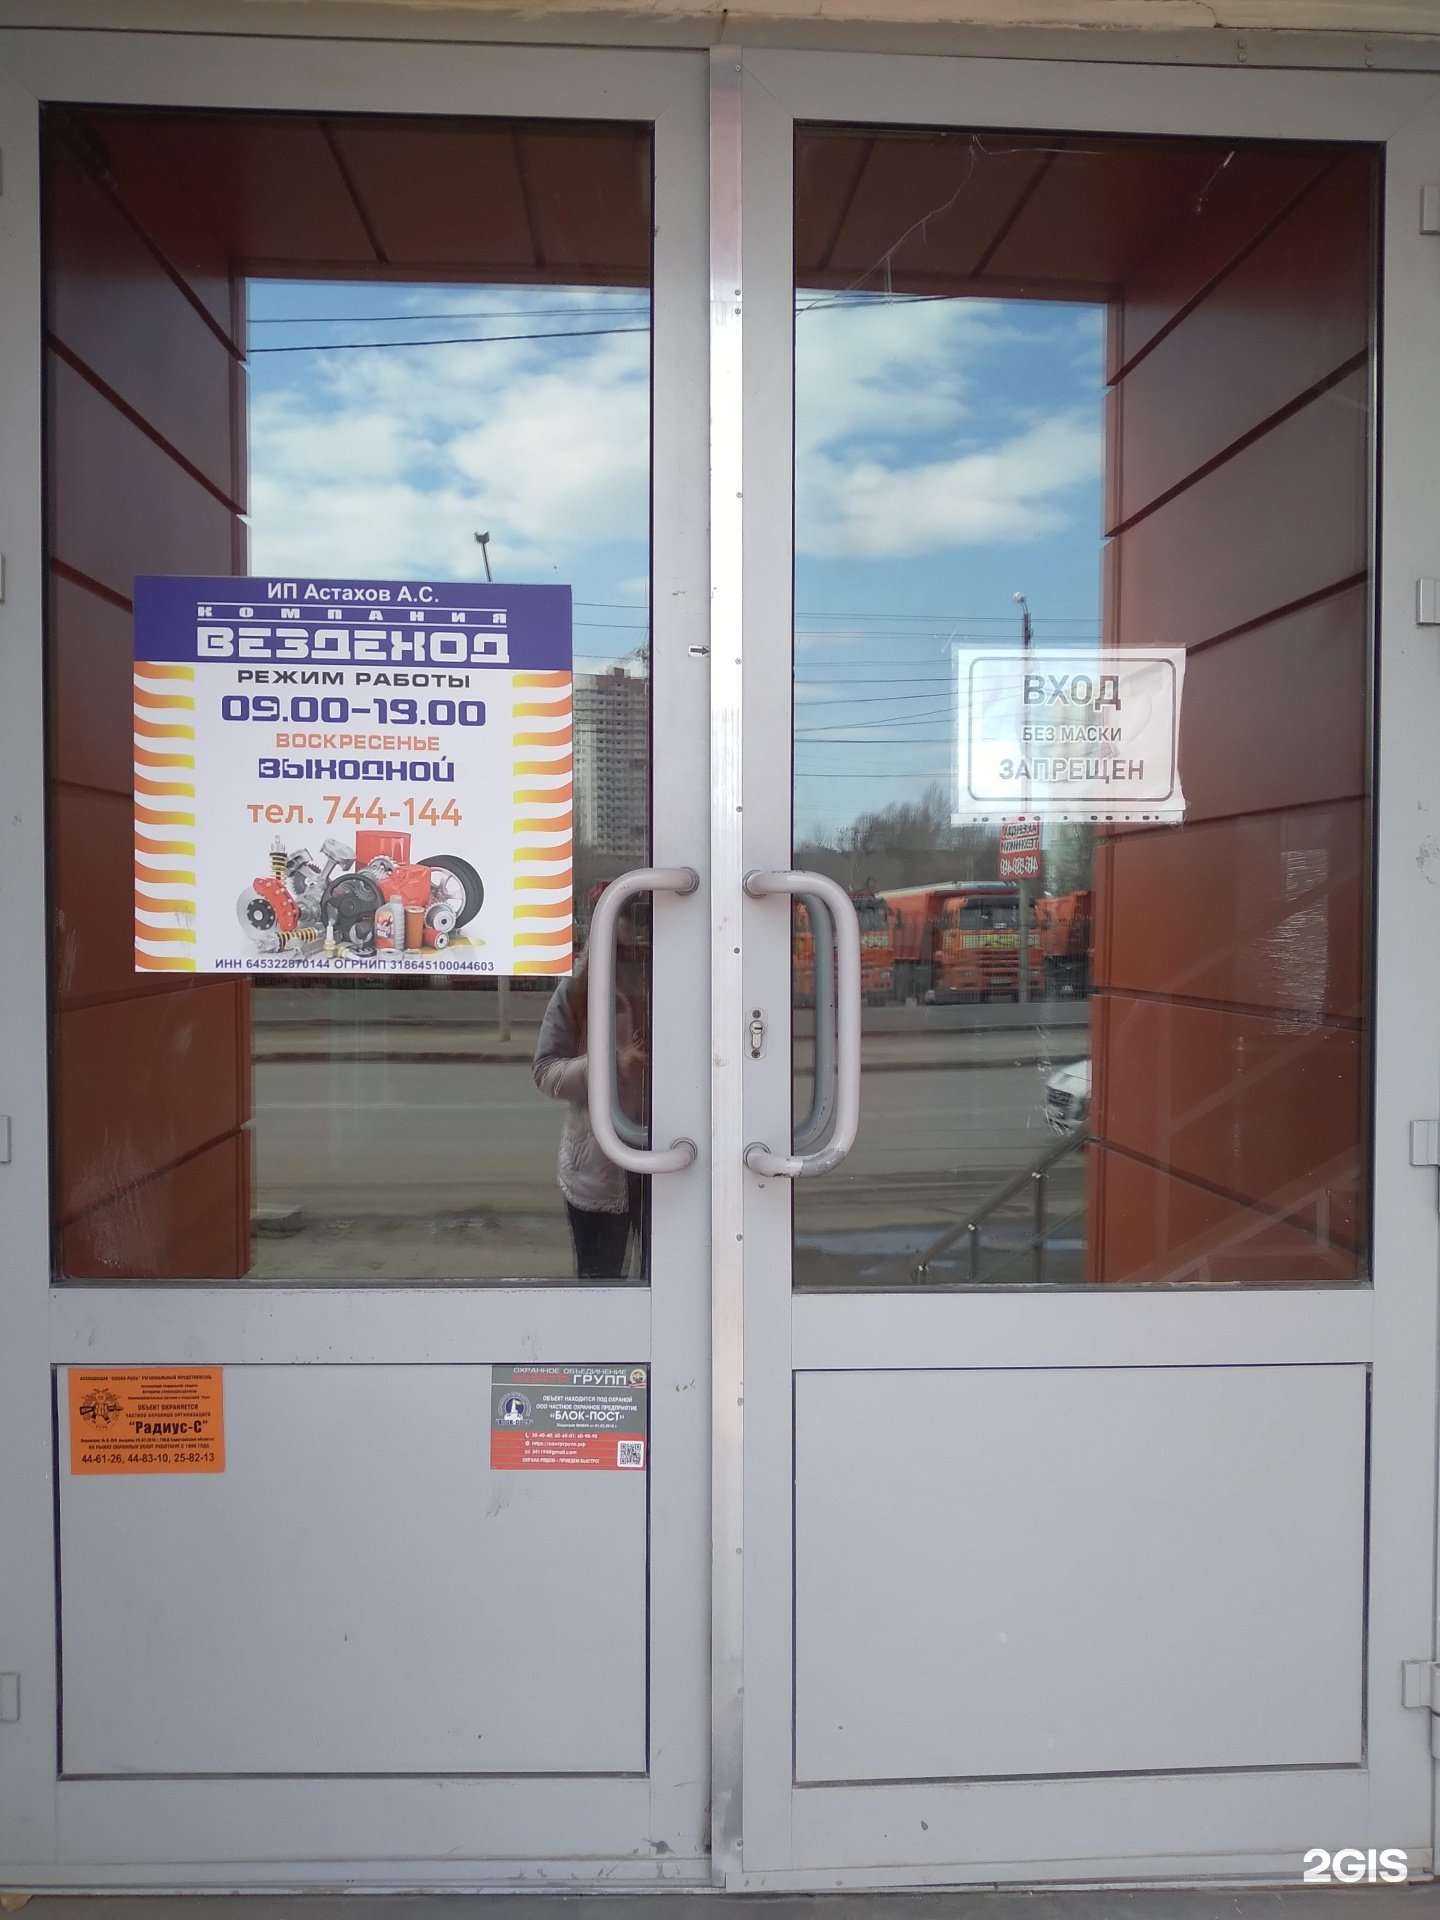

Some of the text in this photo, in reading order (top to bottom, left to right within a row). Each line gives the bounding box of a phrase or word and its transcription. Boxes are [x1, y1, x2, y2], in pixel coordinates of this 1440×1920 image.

[267, 583, 440, 603] ИП Астахов А.С.
[197, 606, 508, 624] КОМПАНИЯ
[196, 626, 510, 664] ВЕЗДЕХОД
[237, 670, 471, 689] РЕЖИМ РАБОТЫ
[1023, 674, 1122, 711] ВХОД
[221, 694, 487, 727] 09.00-19.00
[275, 733, 441, 752] ВОСКРЕСЕНЬЕ
[1022, 726, 1122, 742] БЕЗ МАСКИ
[258, 755, 456, 783] ВЫХОДНОЙ
[999, 759, 1144, 784] ЗАПРЕЩЕН
[247, 796, 463, 826] тел. 744-144
[215, 958, 495, 971] ИНН 645322870144 ОГРНИП 318645100044603
[573, 1374, 627, 1386] ГРУПП
[81, 1452, 215, 1465] 44-61-26, 44-83-10, 25-82-13
